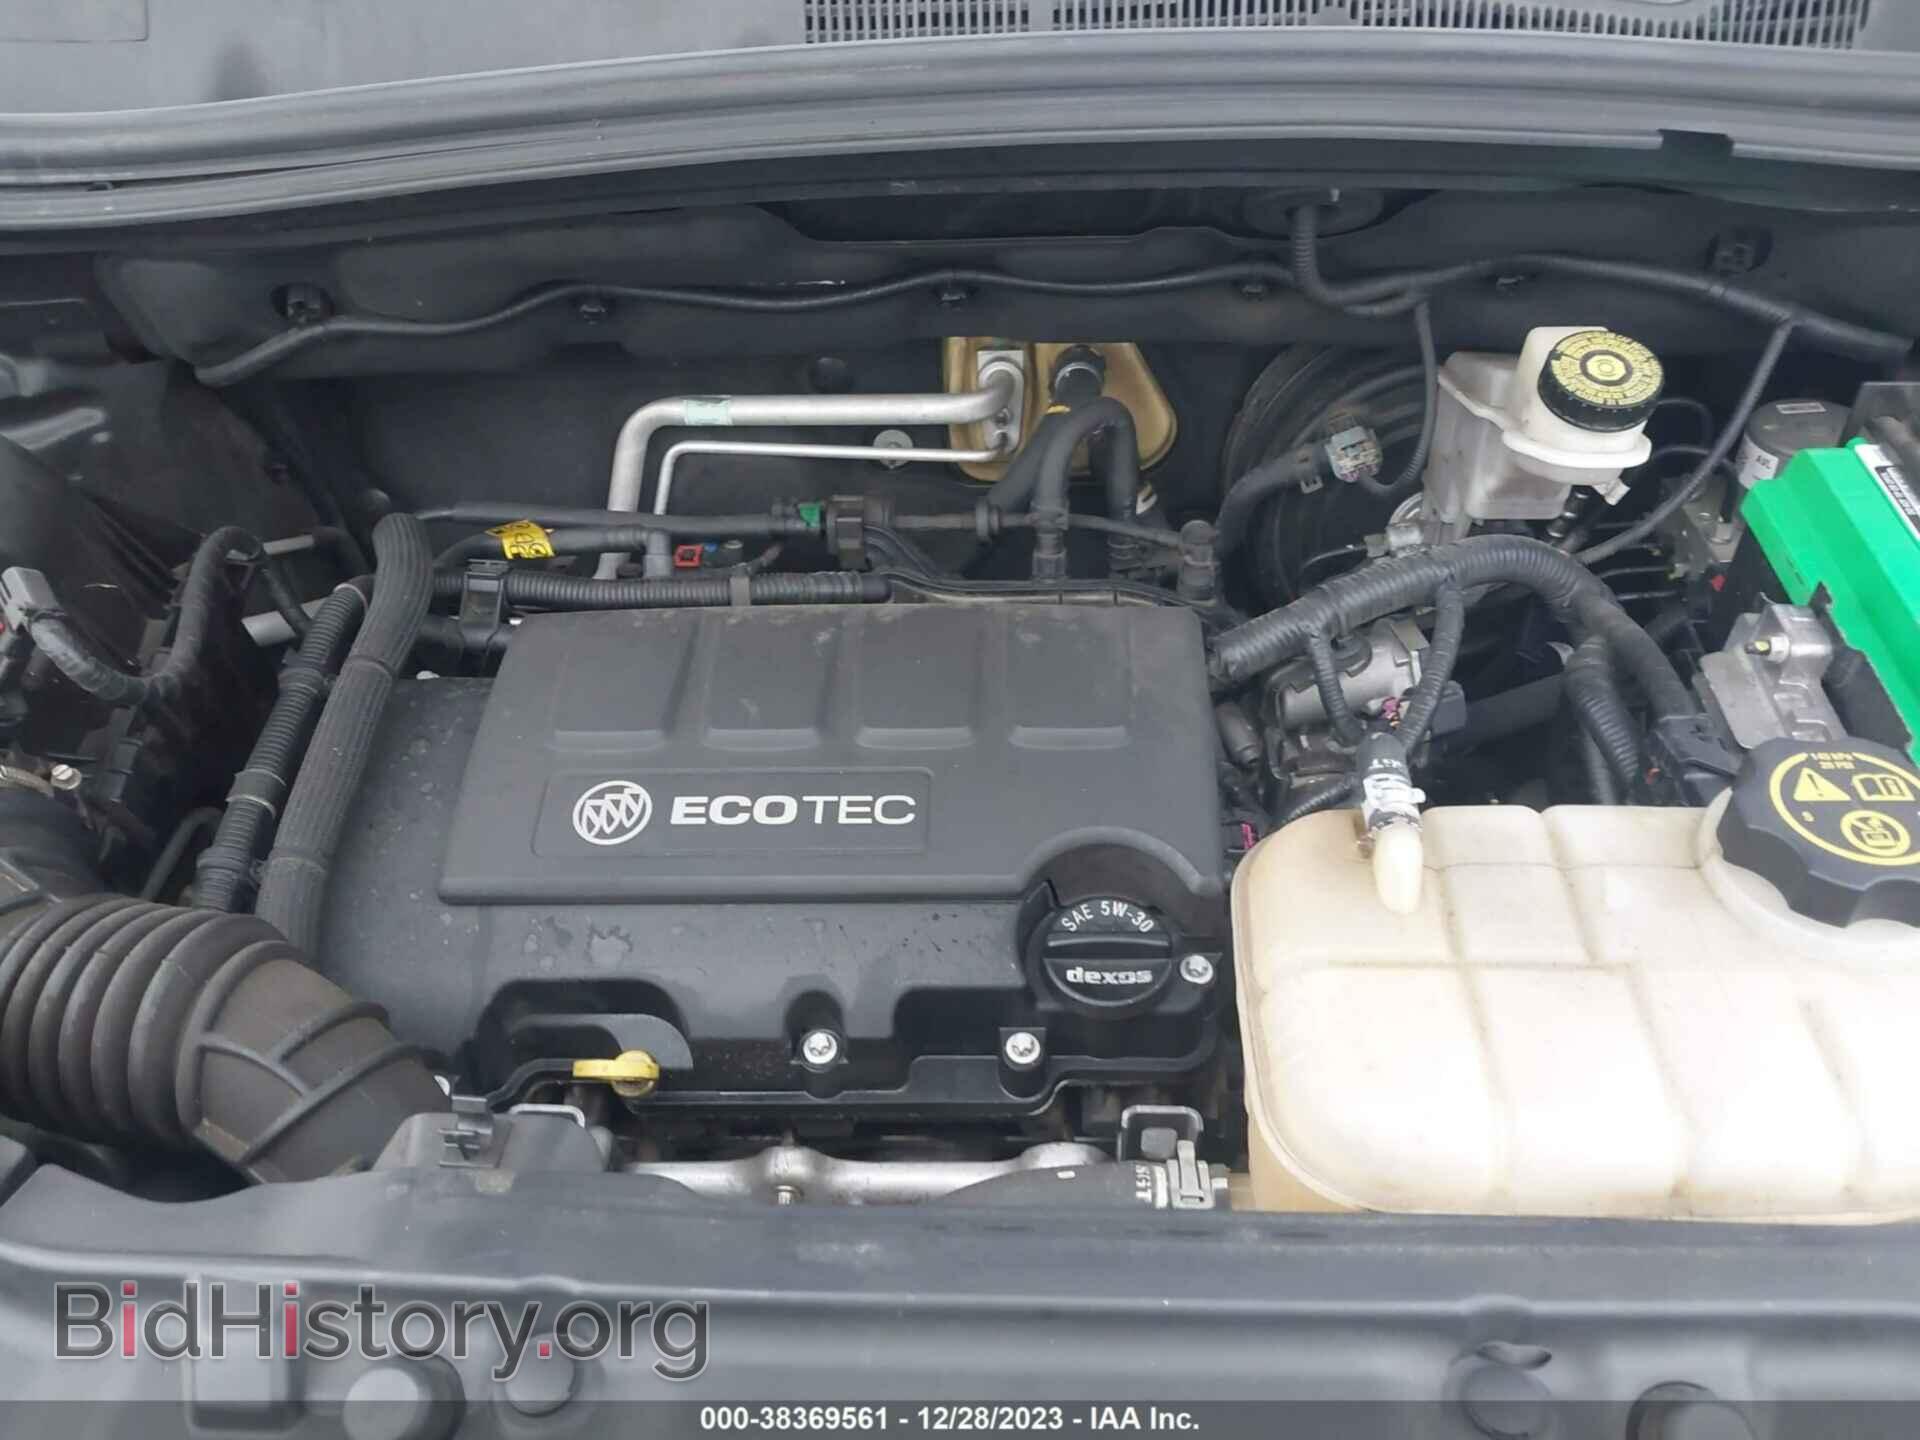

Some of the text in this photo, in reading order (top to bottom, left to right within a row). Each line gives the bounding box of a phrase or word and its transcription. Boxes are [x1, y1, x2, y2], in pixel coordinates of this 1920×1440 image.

[670, 795, 916, 825] ECOTEC
[1062, 900, 1154, 933] SAE 5W-30
[1065, 966, 1153, 985] dexos
